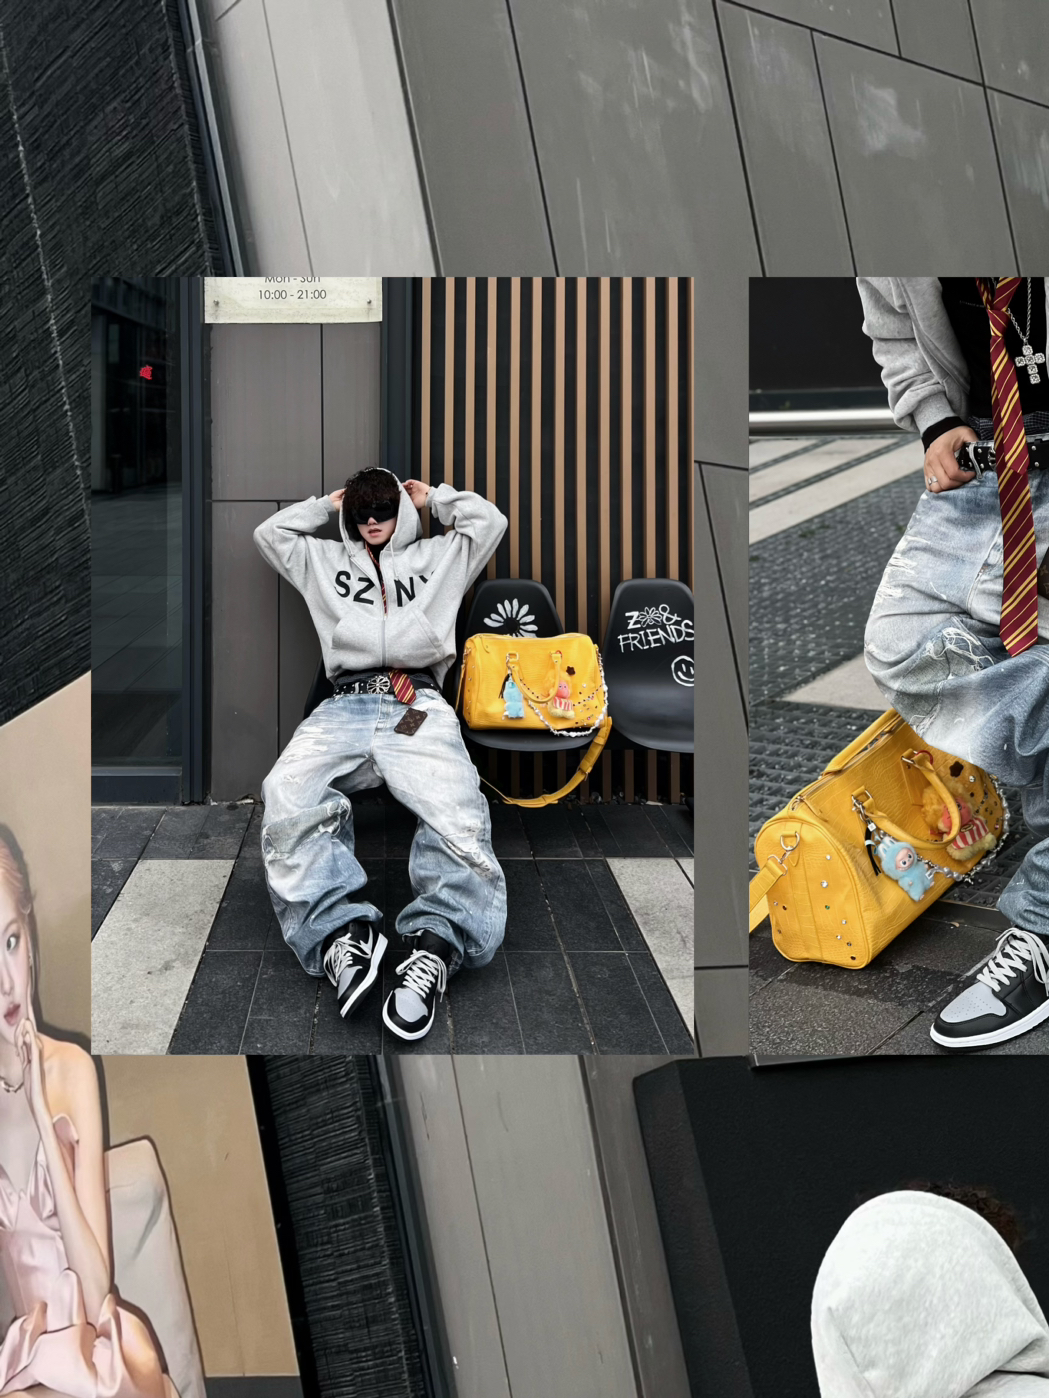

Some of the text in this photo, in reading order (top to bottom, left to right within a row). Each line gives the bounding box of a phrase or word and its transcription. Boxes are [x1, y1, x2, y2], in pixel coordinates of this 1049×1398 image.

[258, 289, 288, 300] 10:00
[297, 289, 327, 300] 21:00
[617, 619, 694, 653] FRIENDS
